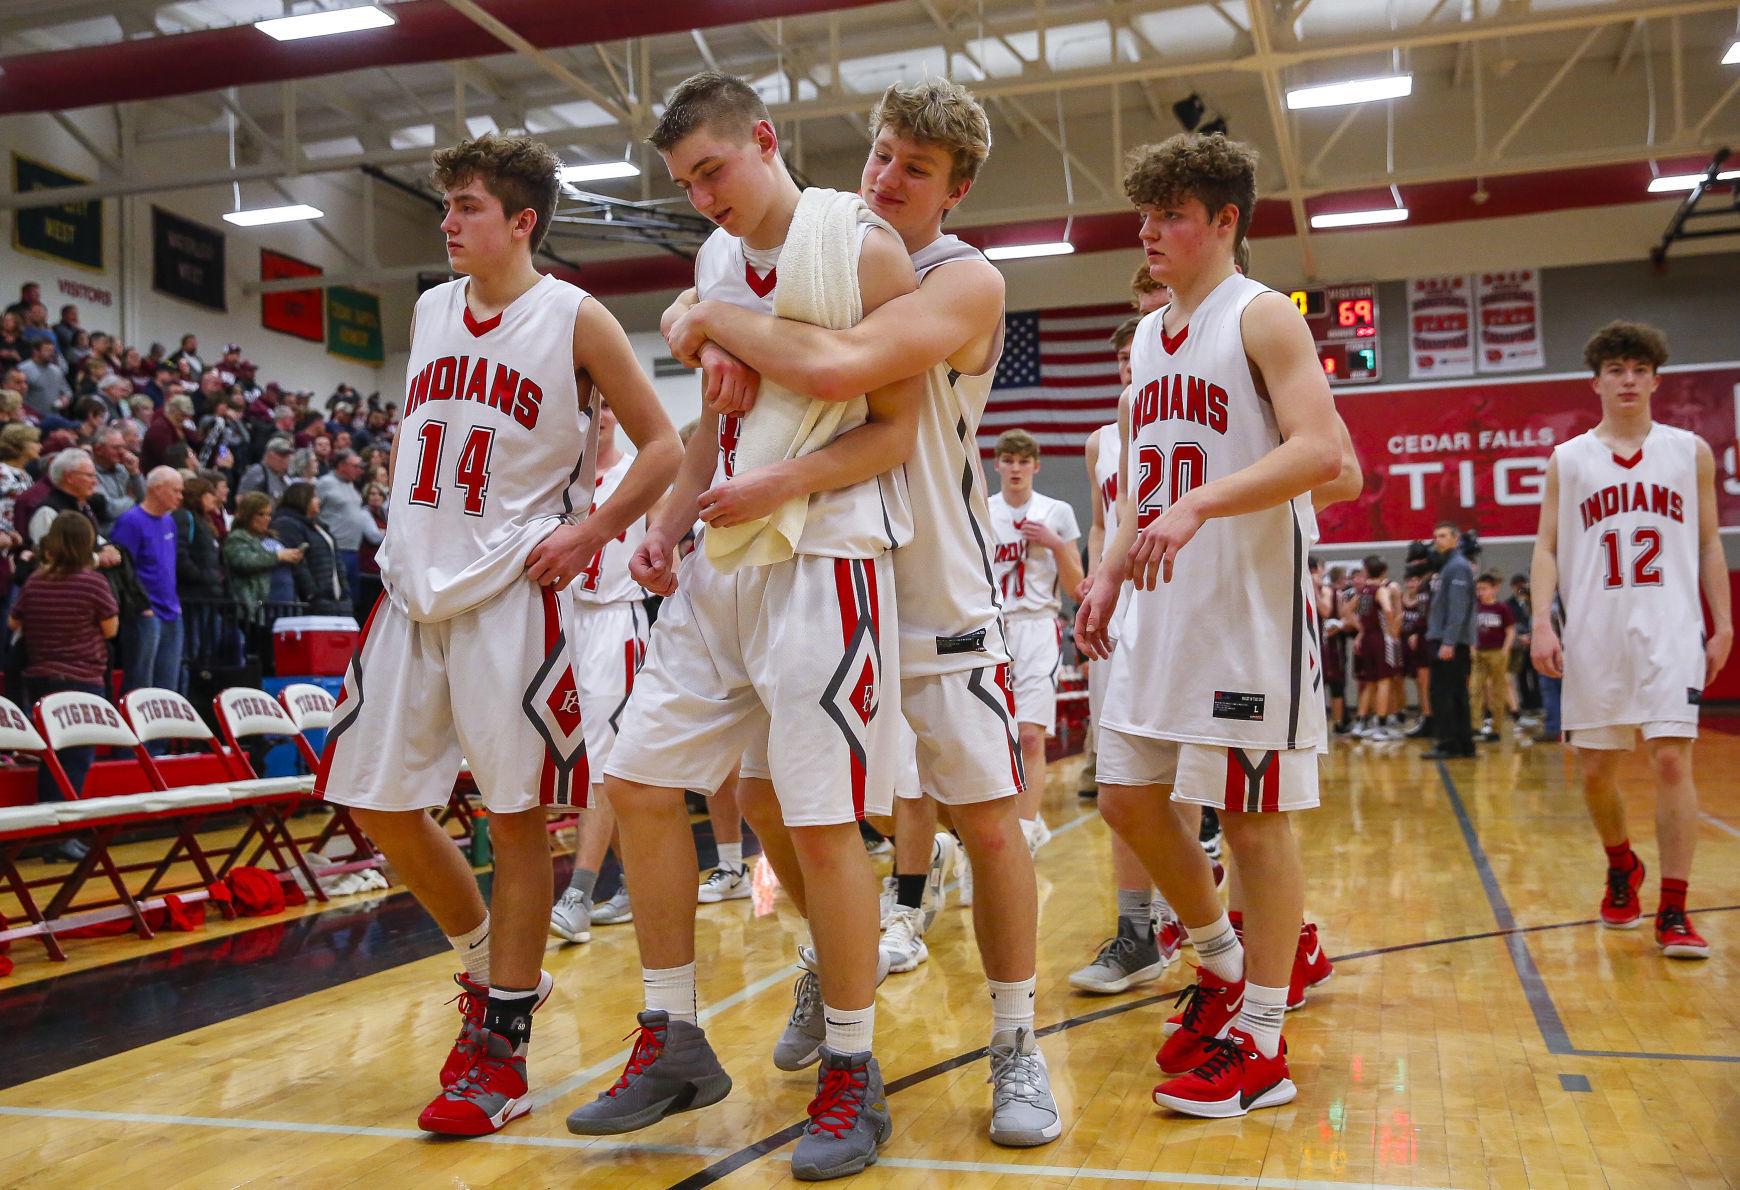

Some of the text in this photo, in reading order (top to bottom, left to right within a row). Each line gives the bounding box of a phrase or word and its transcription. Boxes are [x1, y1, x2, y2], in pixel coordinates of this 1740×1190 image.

[57, 277, 113, 307] VISITORS
[1338, 299, 1373, 327] 69
[404, 355, 543, 431] INDIANS
[1132, 373, 1229, 442] NDIANS
[1387, 426, 1555, 455] CEDAR FALLS
[408, 418, 497, 518] 14
[1138, 441, 1208, 534] 20
[1580, 481, 1685, 533] INDIANS
[1600, 525, 1664, 591] 12
[51, 702, 120, 731] TIGERS
[136, 698, 197, 724] TIGERS
[230, 696, 284, 721] TIGERS
